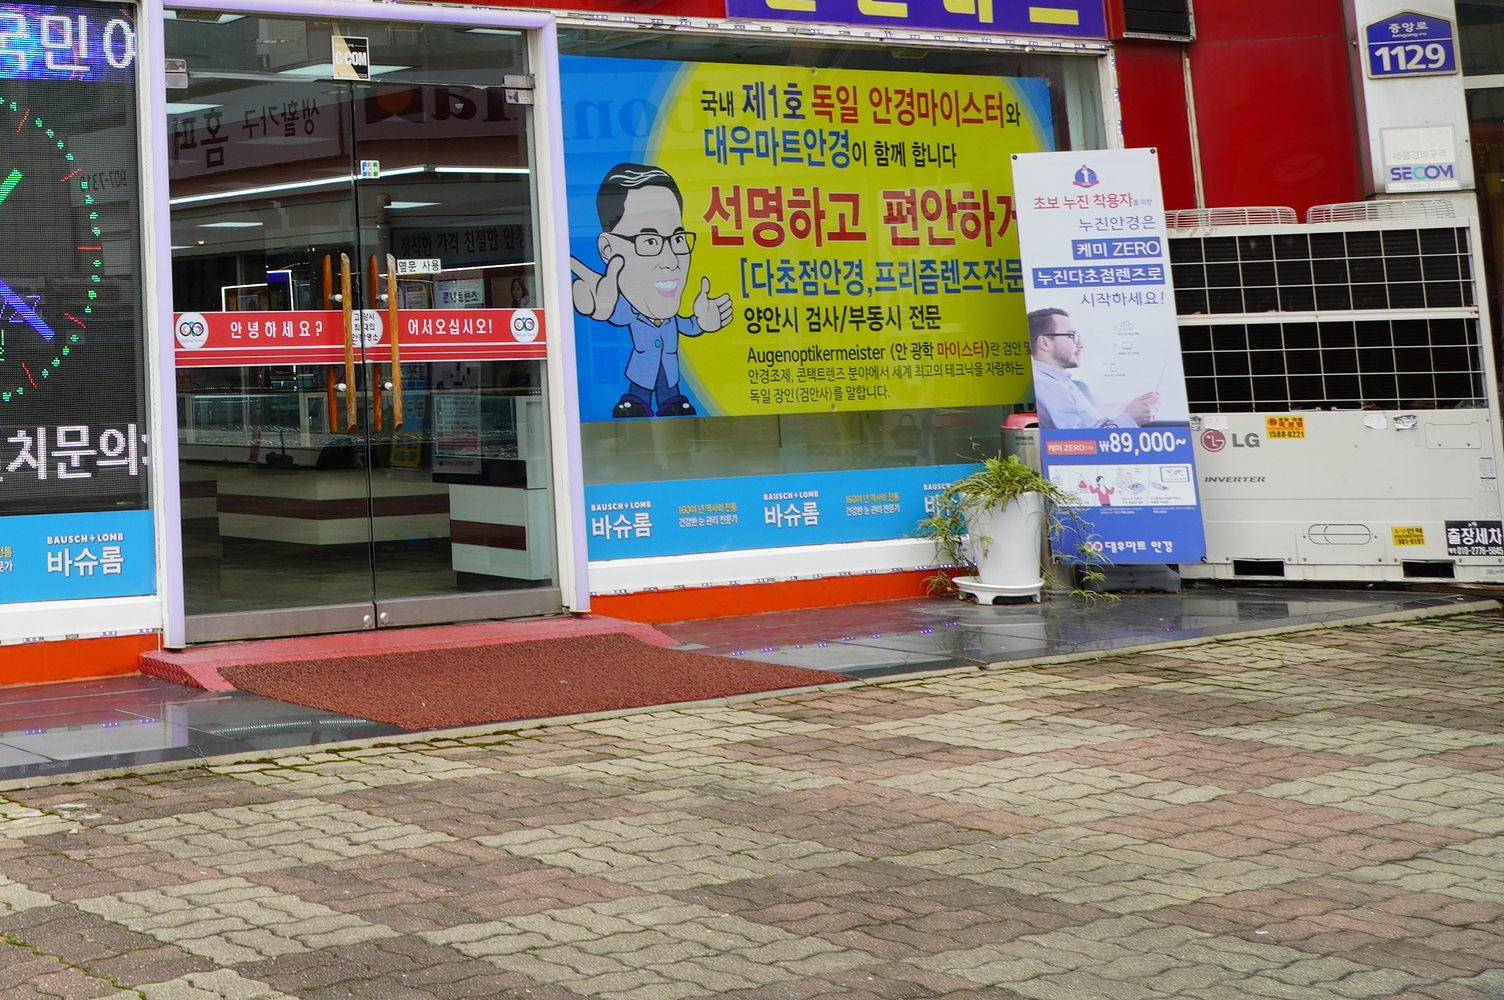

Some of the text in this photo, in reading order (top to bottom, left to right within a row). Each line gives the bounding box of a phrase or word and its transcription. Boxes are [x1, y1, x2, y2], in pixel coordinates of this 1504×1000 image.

[1388, 21, 1429, 34] 중앙로
[1374, 43, 1446, 72] 1129
[701, 90, 735, 118] 국내
[742, 81, 806, 121] 제1호
[811, 84, 859, 124] 독일
[869, 86, 1021, 129] 안경마이스터와
[703, 125, 957, 169] 대우마트안경이 함께 합니다
[1390, 164, 1454, 182] SECOM
[1034, 196, 1060, 210] 초보
[1063, 194, 1090, 210] 누진
[702, 185, 867, 249] 선명하고
[1079, 215, 1156, 232] 누진안경은
[1076, 240, 1160, 258] 케미 ZERO
[422, 259, 440, 273] 사용
[1037, 267, 1163, 286] 누진다초점렌즈로
[1081, 291, 1164, 308] 시작하세요!
[408, 318, 493, 336] 어서오십시오!
[744, 304, 941, 334] 양안시 검사/부동시 전문
[229, 320, 323, 340] 안녕하세요?
[747, 344, 886, 368] Augenoptikermeister
[890, 340, 908, 361] (안
[910, 341, 934, 361] 광학
[1002, 341, 1022, 356] 검안
[748, 360, 1025, 385] 안경조제, 콘택트렌즈 분야에서 세계 최고의 테크닉을 자랑하는
[749, 388, 771, 404] 독일
[846, 384, 891, 401] 말합니다.
[1231, 432, 1260, 448] LG
[764, 501, 820, 528] 바슈롬
[590, 511, 653, 541] 바슈롬
[46, 532, 125, 545] BAUSCH+LOMB
[1447, 527, 1502, 546] 출장세차
[1150, 540, 1173, 554] 안경
[47, 546, 125, 578] 바슈롬
